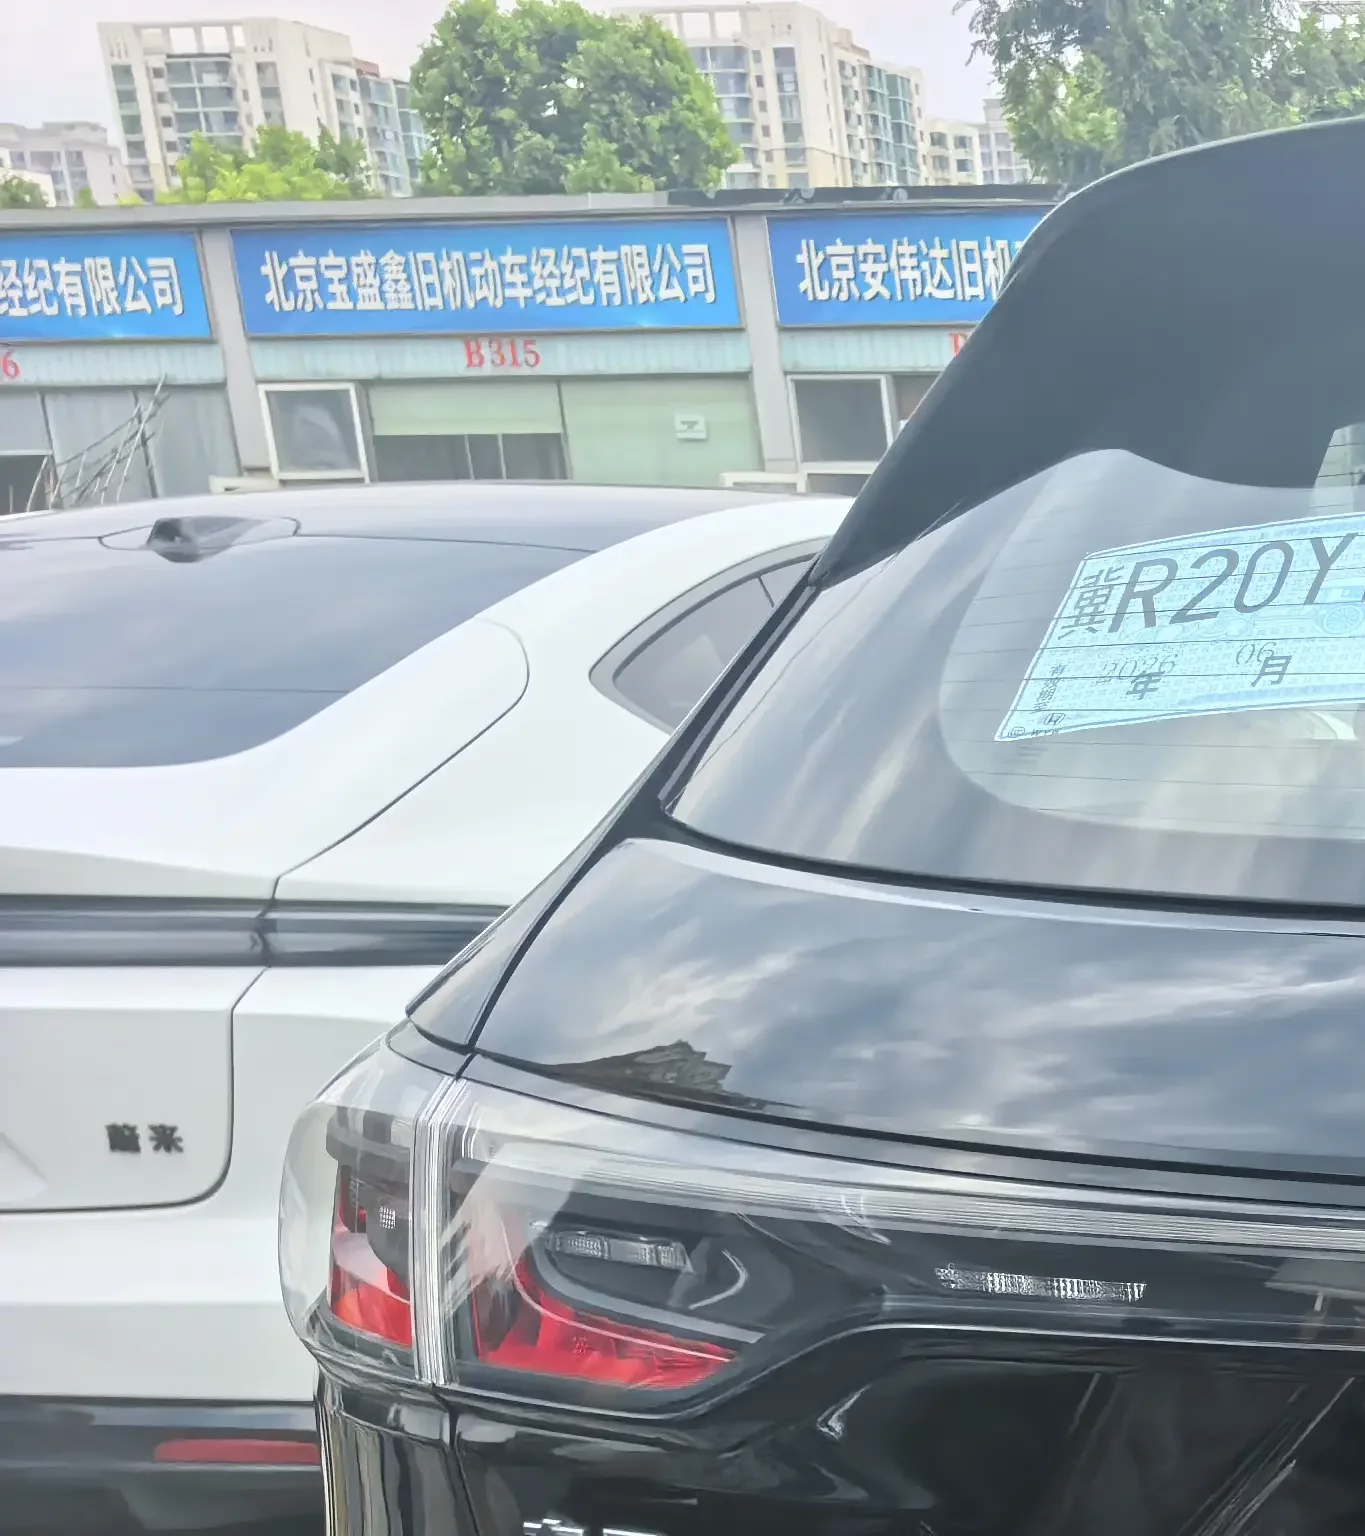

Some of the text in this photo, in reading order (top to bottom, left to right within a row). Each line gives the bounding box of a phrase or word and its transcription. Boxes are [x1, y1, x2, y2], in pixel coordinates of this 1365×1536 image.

[0, 256, 184, 316] 经纪有限公司
[261, 243, 716, 313] 北京宝盛鑫旧机动车经纪有限公司
[796, 236, 1024, 301] 北京安伟达旧机
[464, 337, 541, 368] B315
